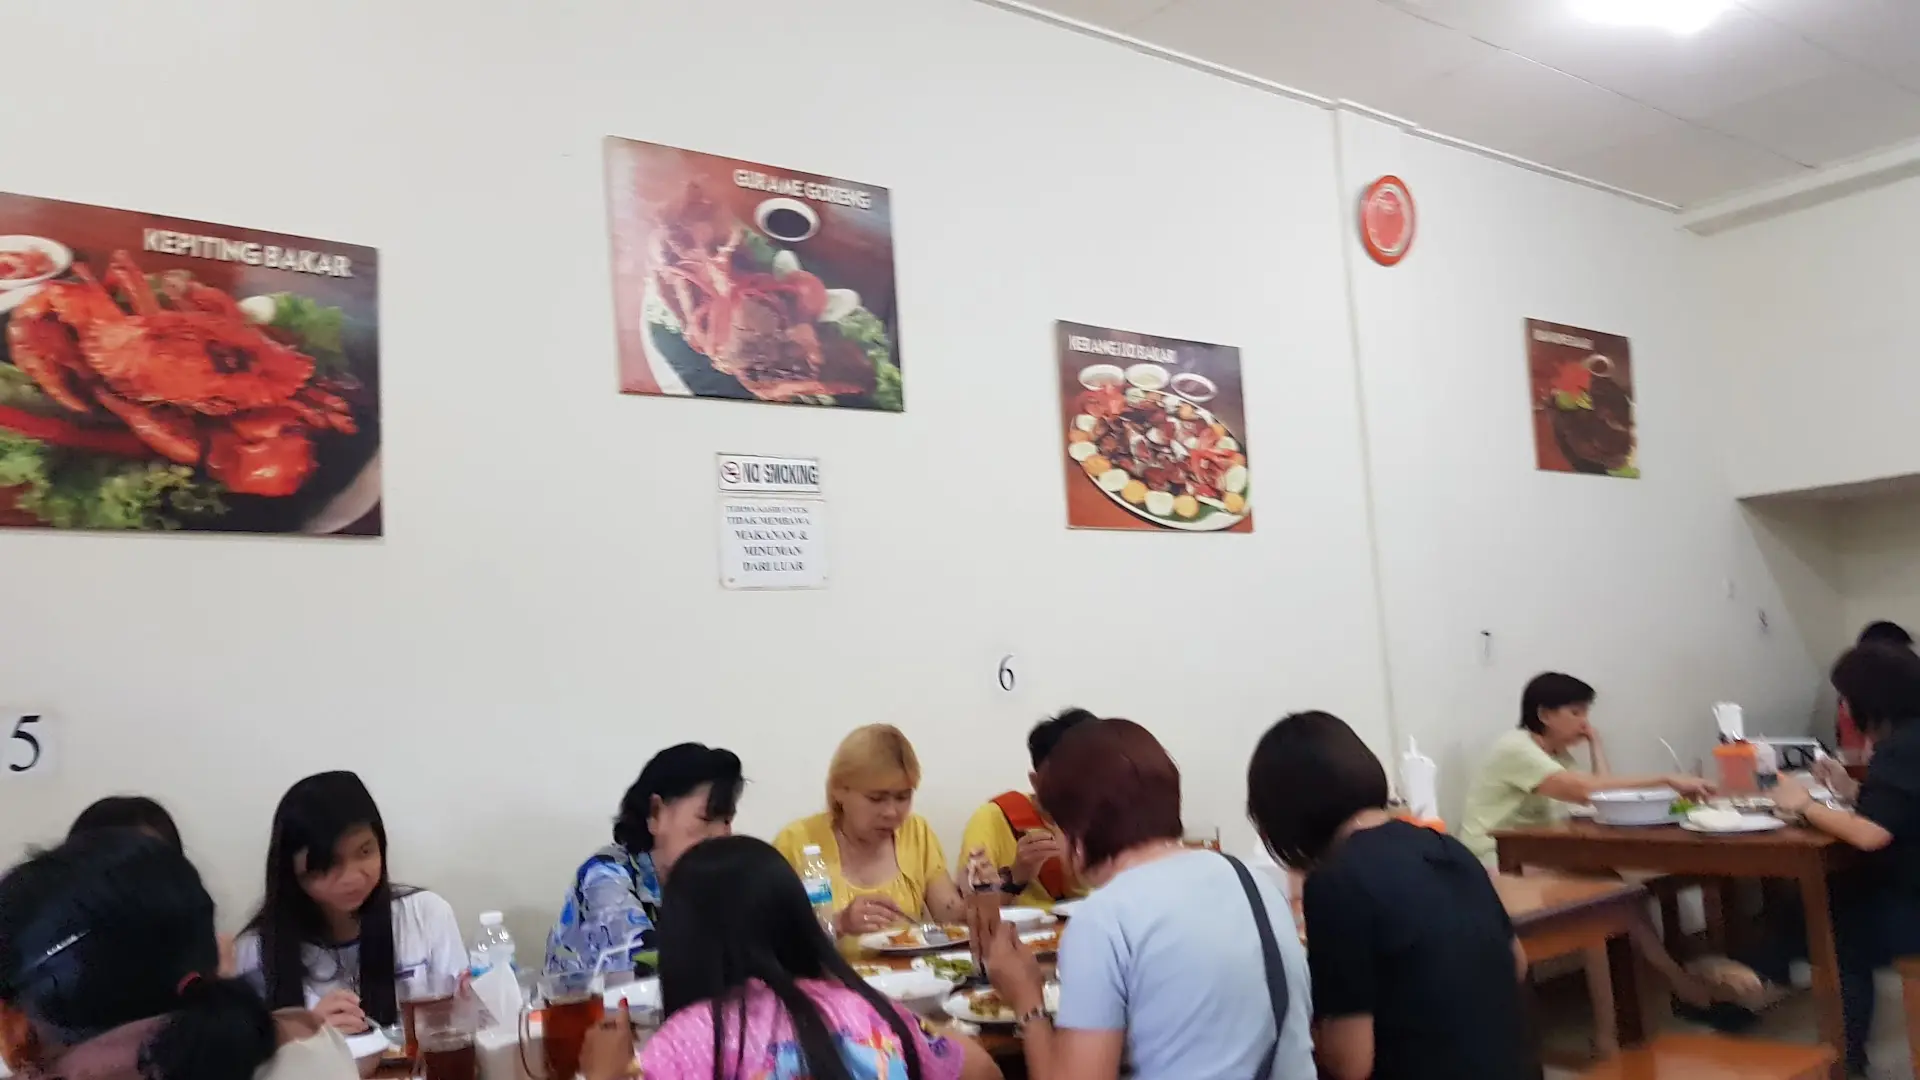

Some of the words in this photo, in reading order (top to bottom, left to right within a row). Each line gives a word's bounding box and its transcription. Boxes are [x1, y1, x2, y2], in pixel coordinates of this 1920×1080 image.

[143, 227, 264, 266] KEPITING
[264, 245, 354, 278] BAKAR
[742, 462, 760, 483] NO
[763, 463, 819, 485] SMOKING
[726, 516, 757, 525] TIDAK
[735, 530, 796, 541] MAKANAN
[798, 530, 808, 541] &
[743, 546, 803, 556] MINUMAN
[742, 561, 769, 572] DARI
[772, 561, 804, 572] LUAR
[999, 654, 1015, 692] 6
[9, 714, 42, 772] 5
